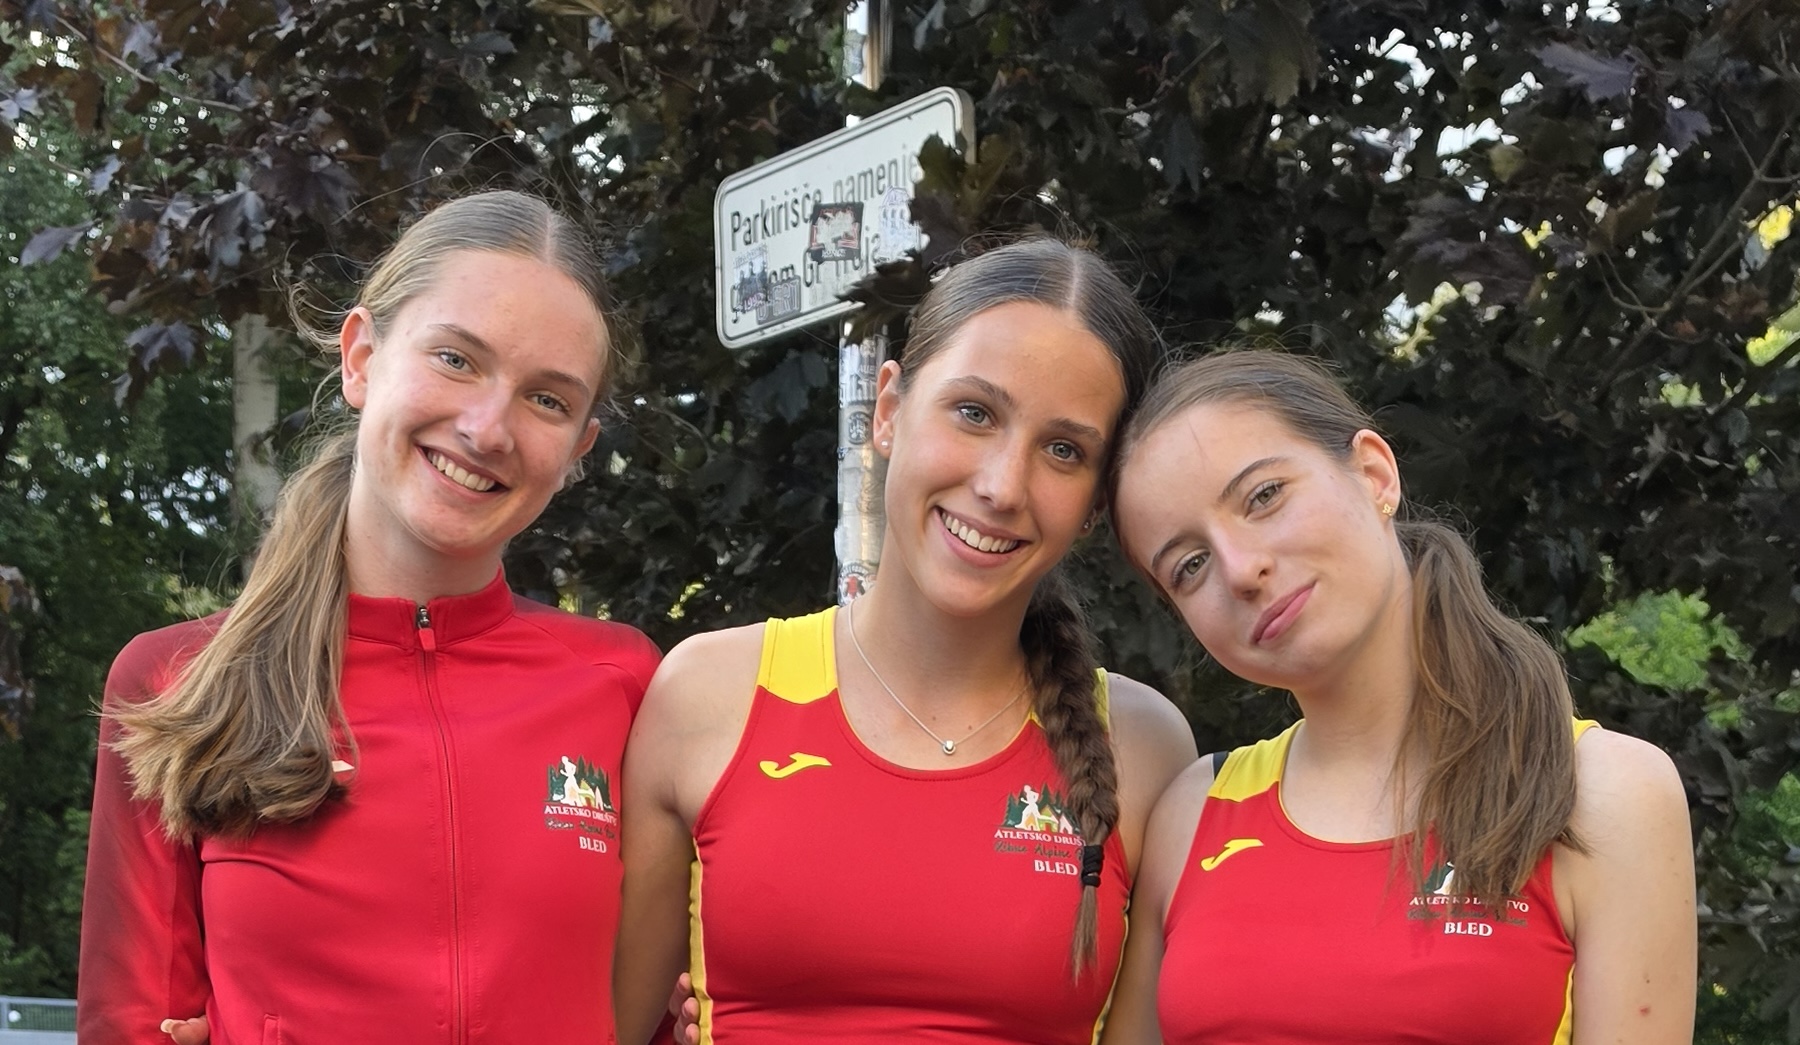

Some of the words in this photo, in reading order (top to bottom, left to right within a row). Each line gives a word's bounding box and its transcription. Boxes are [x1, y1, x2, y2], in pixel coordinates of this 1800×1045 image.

[731, 182, 823, 251] Parkirišče
[833, 143, 918, 204] namenje
[544, 805, 591, 818] ATLETSKO
[994, 829, 1052, 842] ATLETSKO
[579, 836, 607, 853] BLED
[1034, 859, 1078, 876] BLED
[1444, 921, 1493, 937] BLED
